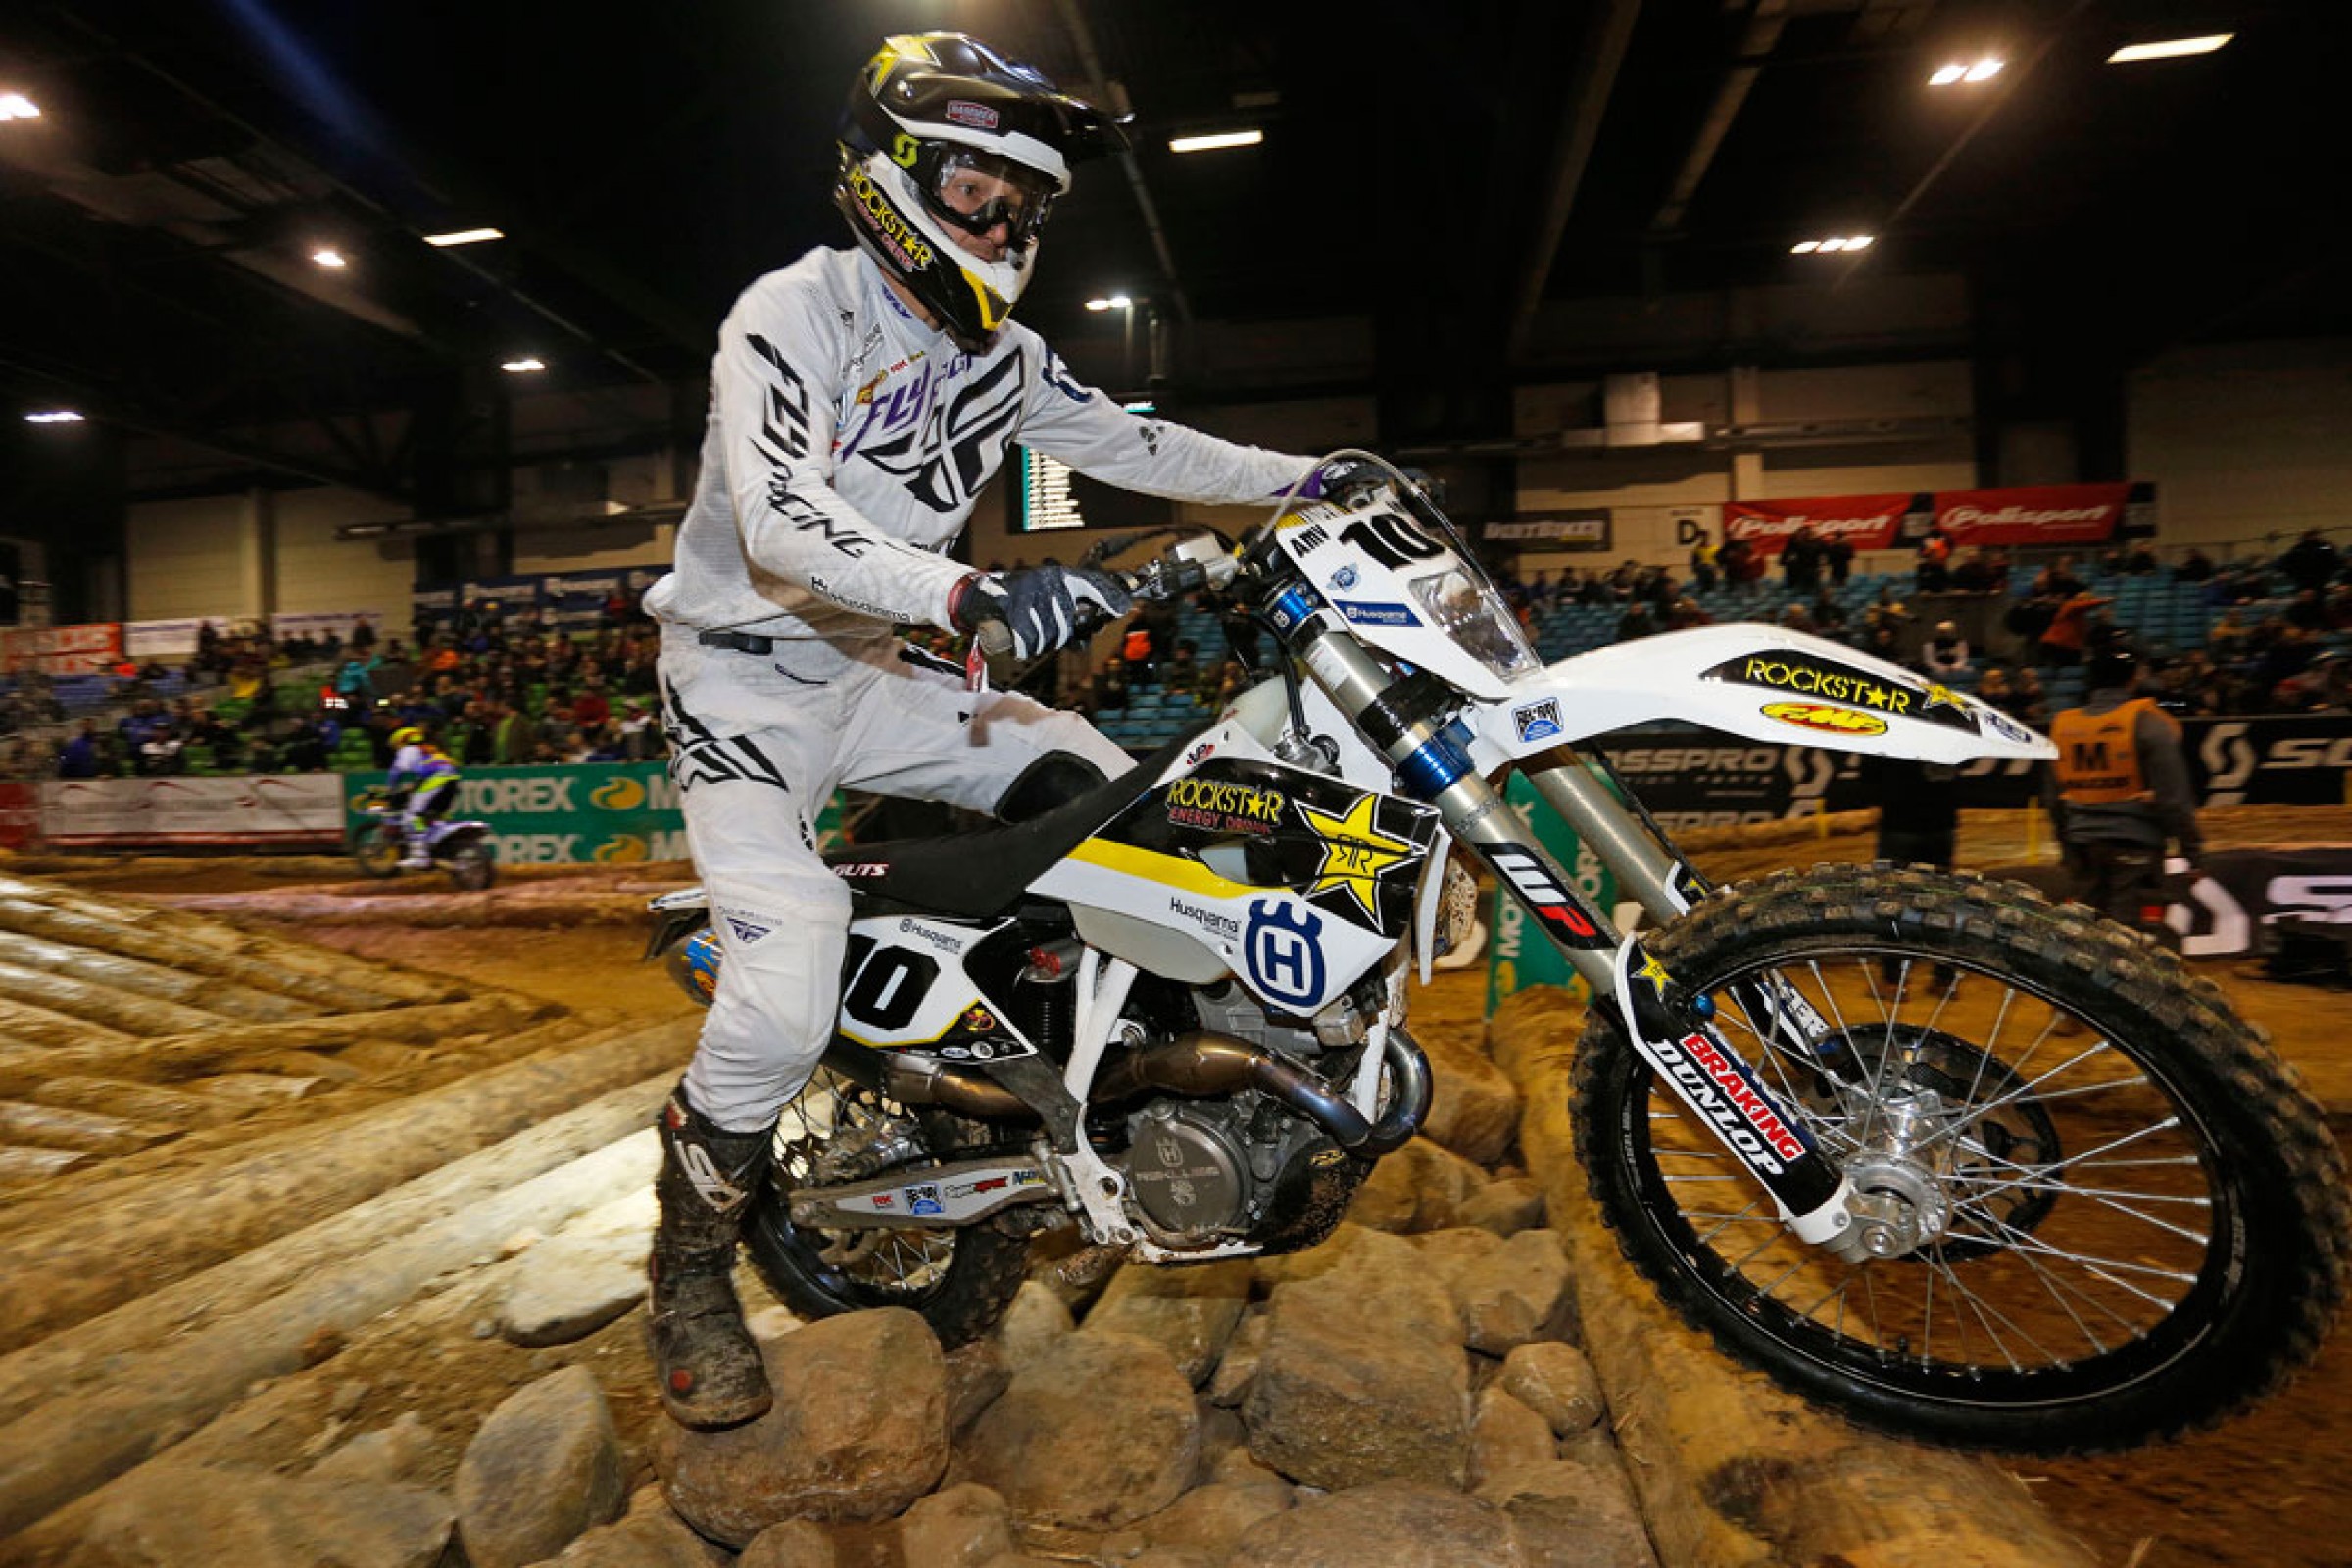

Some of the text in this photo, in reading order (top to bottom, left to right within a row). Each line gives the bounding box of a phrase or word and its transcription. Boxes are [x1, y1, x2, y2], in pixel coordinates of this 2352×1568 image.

[1339, 514, 1446, 572] 10
[1169, 896, 1239, 932] Husqvarna
[1651, 1039, 1785, 1175] DUNLOP
[1679, 1031, 1807, 1161] BRAKING
